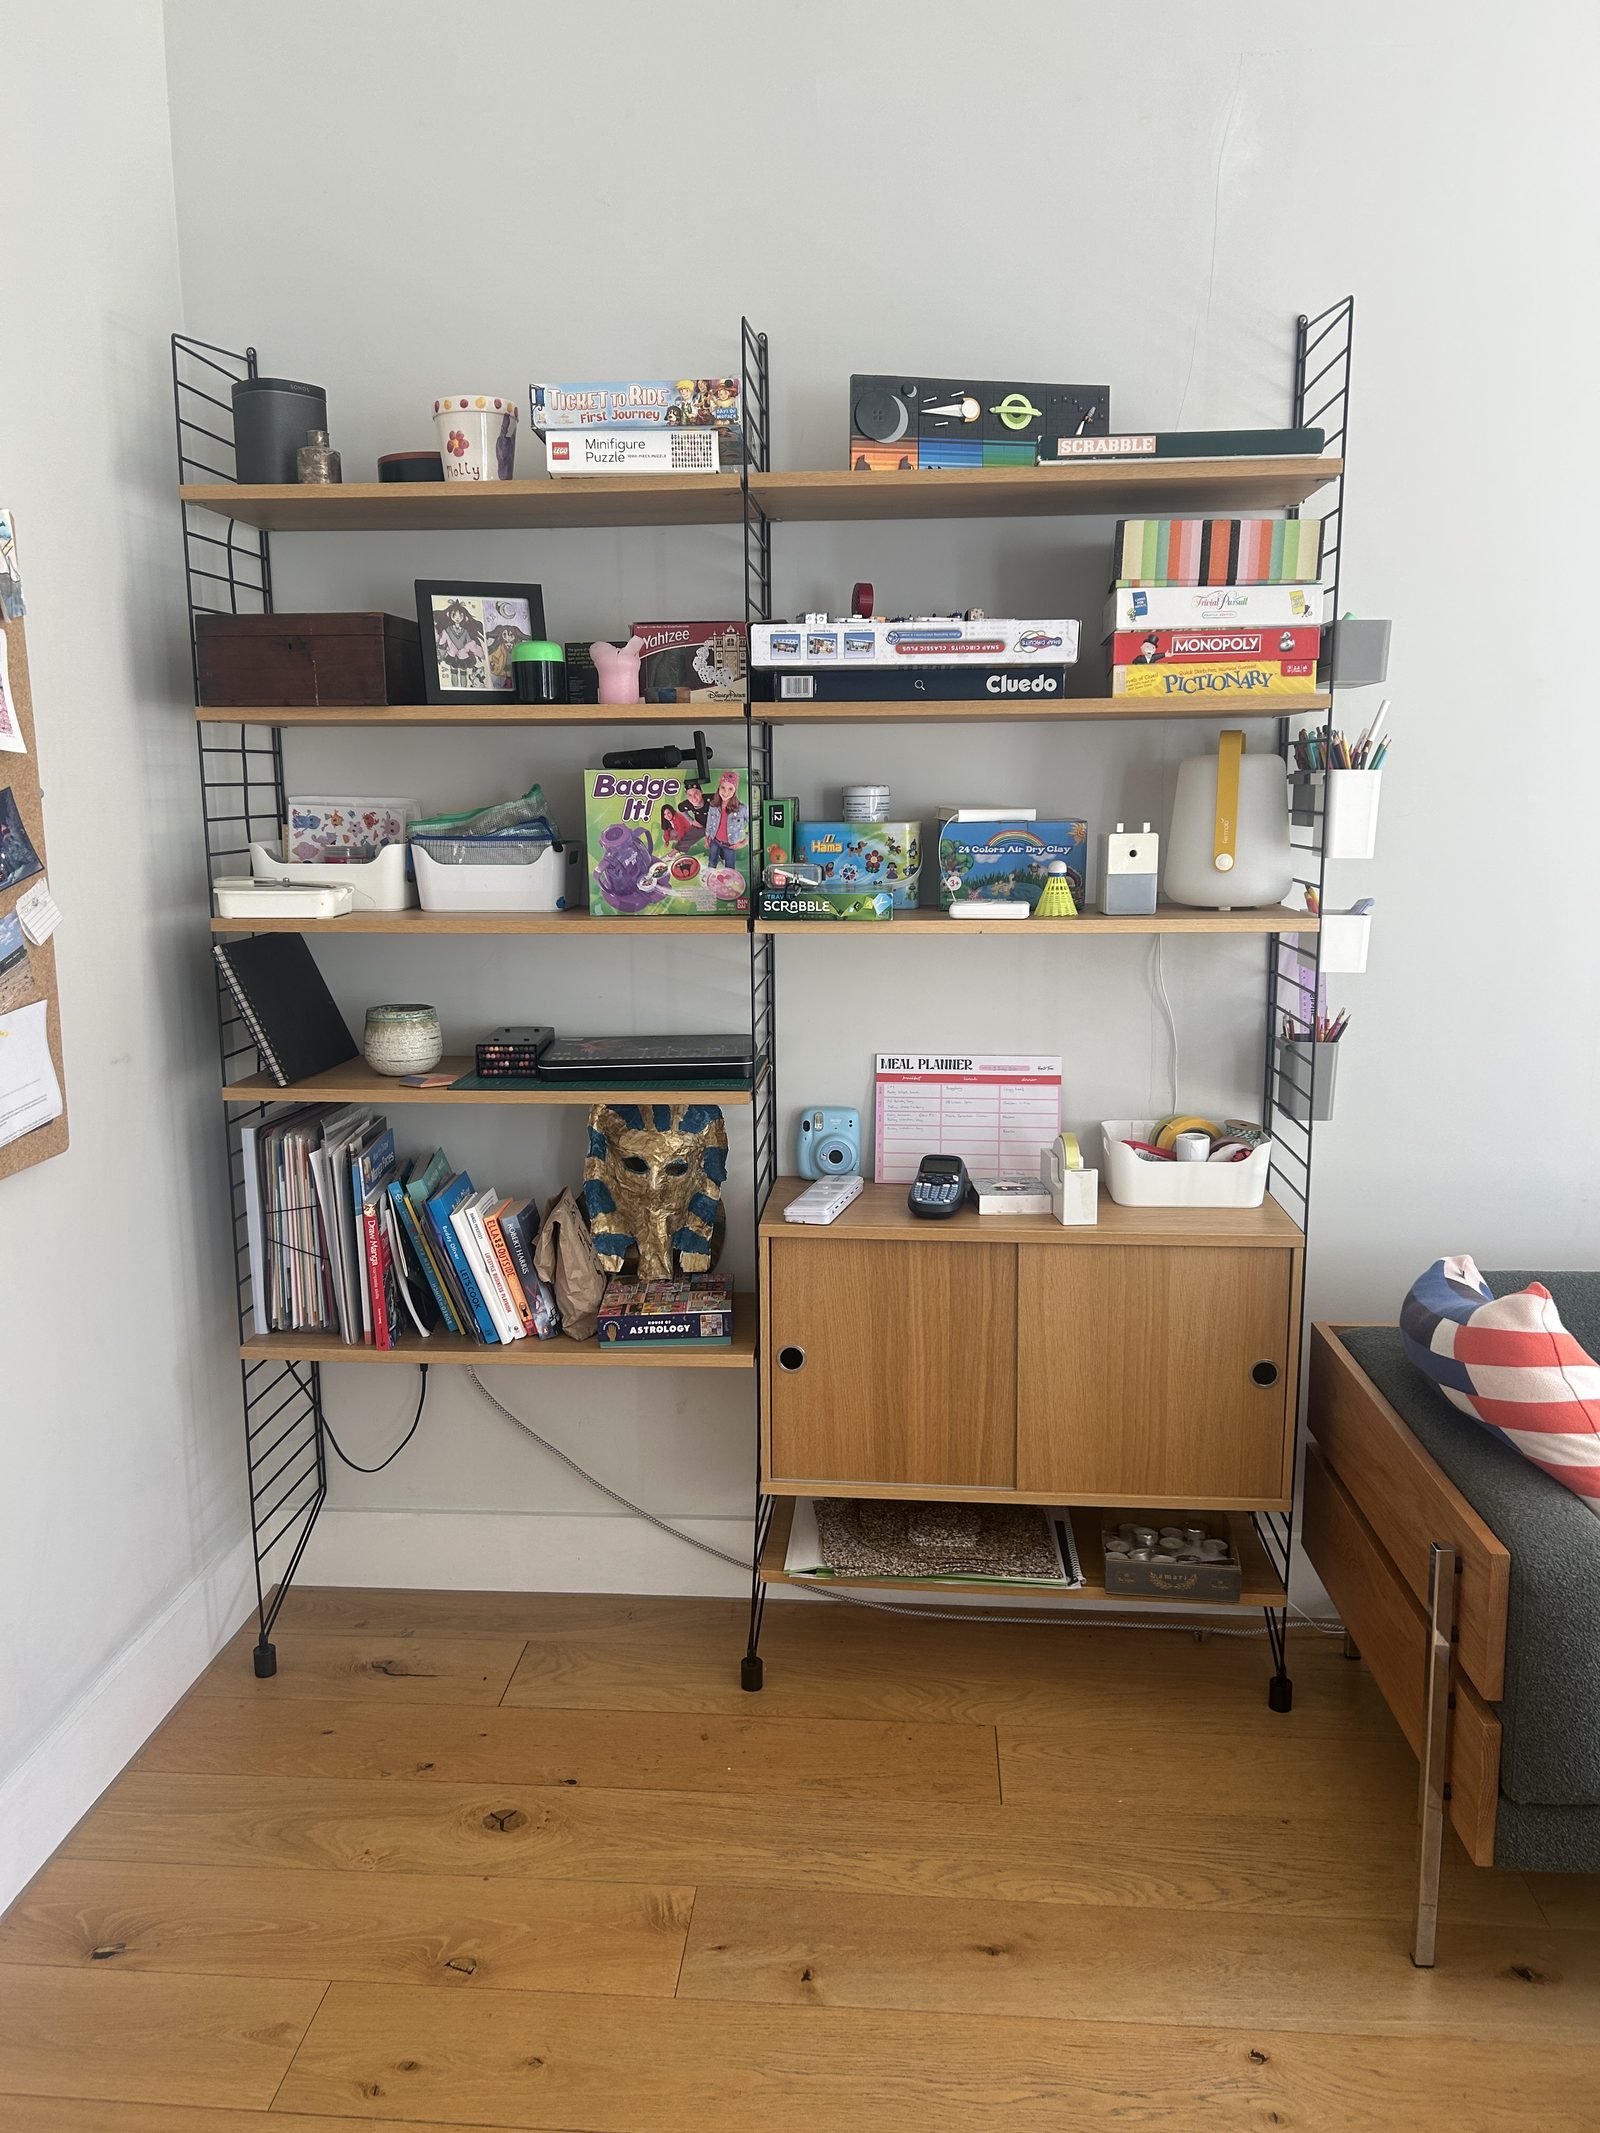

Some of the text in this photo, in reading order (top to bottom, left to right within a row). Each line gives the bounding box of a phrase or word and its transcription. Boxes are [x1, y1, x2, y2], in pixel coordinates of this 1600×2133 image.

[290, 384, 310, 392] SONOS
[548, 384, 669, 411] TICKET TO RIDE
[580, 412, 607, 423] First
[612, 409, 660, 421] Journey
[585, 438, 645, 452] Minifigure
[1061, 438, 1153, 454] SCRABBLE
[585, 451, 625, 463] Puzzle
[447, 463, 480, 481] Molly
[1192, 590, 1249, 610] Trivial Pursuit
[643, 625, 690, 649] Yahtzee
[1175, 637, 1259, 652] MONOPOLY
[986, 674, 1057, 694] Cluedo
[1163, 670, 1273, 694] PICTIONARY
[593, 774, 680, 800] Badge
[623, 798, 653, 821] It!
[774, 811, 782, 820] 12
[812, 841, 843, 853] Hama
[972, 845, 1005, 854] Colors
[1007, 845, 1024, 853] Air
[1025, 845, 1045, 855] Dry
[1046, 845, 1072, 854] Clay
[950, 879, 959, 887] 3+
[764, 901, 831, 913] SCRABBLE
[881, 1058, 914, 1069] MEAL
[918, 1058, 973, 1070] PLANNER
[367, 1219, 376, 1239] Draw
[441, 1225, 461, 1260] Buddy Oliver
[486, 1219, 500, 1240] ELLA
[496, 1247, 516, 1279] OUTSIDE
[506, 1222, 530, 1275] ROBERT HARRIS
[369, 1239, 379, 1267] Manga
[459, 1268, 482, 1310] LET'S COOK
[484, 1252, 512, 1313] LIFESTYLE BUSINESS PLAYBOOK
[629, 1325, 690, 1335] ASTROLOGY
